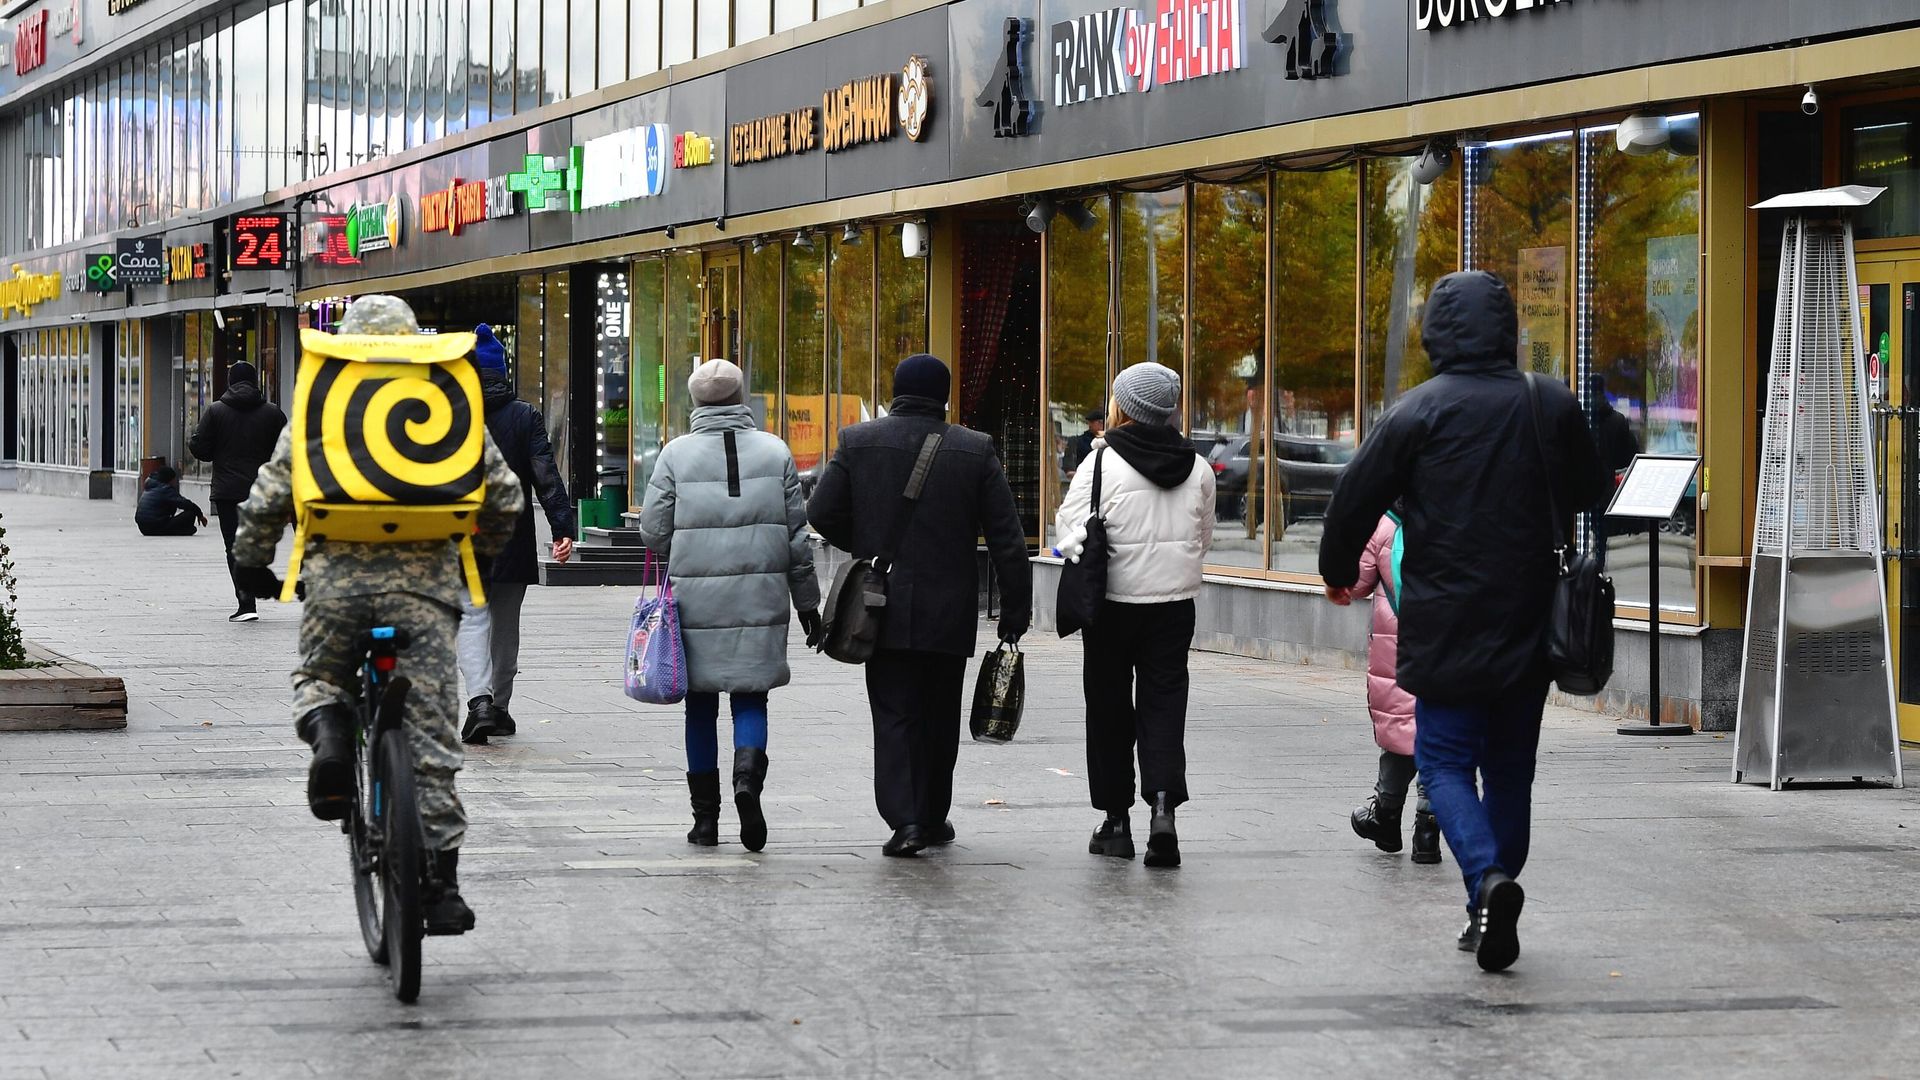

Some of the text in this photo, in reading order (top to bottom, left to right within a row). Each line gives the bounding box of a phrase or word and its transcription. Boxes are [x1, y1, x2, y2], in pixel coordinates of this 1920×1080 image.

[1052, 7, 1157, 106] FRANK by
[730, 114, 788, 166] ЛЕГЕНДАРНОЕ
[789, 107, 816, 154] КАФЕ
[823, 76, 893, 151] ВАРЕНИЧНАЯ
[647, 146, 658, 172] 366
[236, 217, 280, 230] ДОНЕР
[236, 233, 282, 265] 24
[1652, 279, 1671, 297] BOWL
[605, 302, 621, 338] ONE
